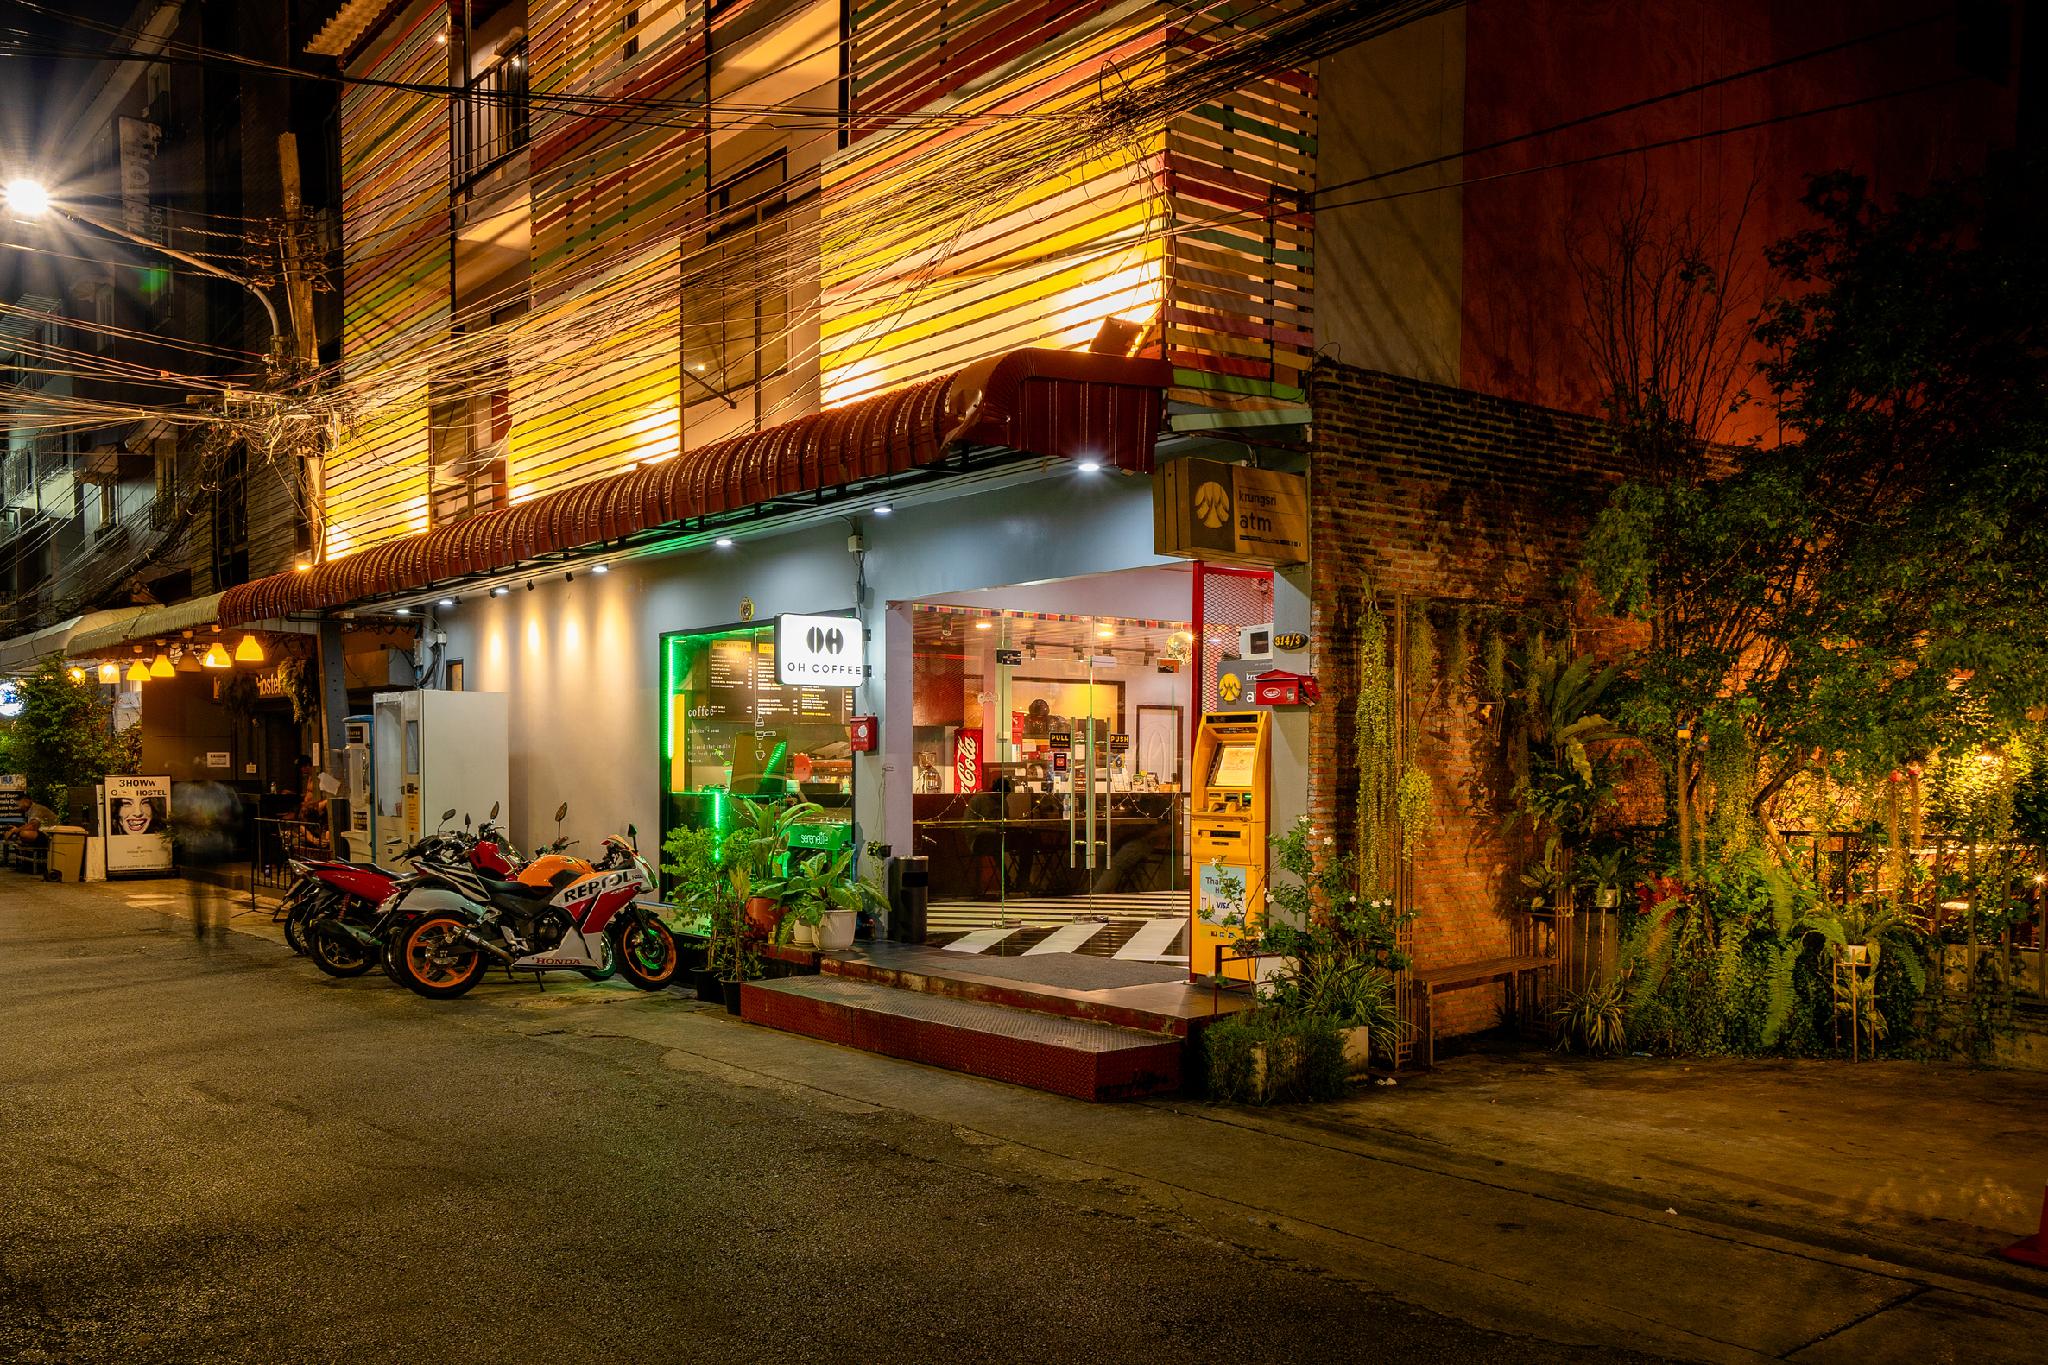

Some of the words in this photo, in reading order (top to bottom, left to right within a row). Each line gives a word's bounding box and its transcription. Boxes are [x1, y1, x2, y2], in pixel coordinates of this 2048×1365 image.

[1239, 490, 1277, 507] krungsri
[1240, 512, 1272, 532] atm
[787, 662, 806, 672] OH
[811, 664, 862, 675] COFFEE
[1110, 735, 1129, 743] PUSH
[536, 957, 582, 965] HONDA
